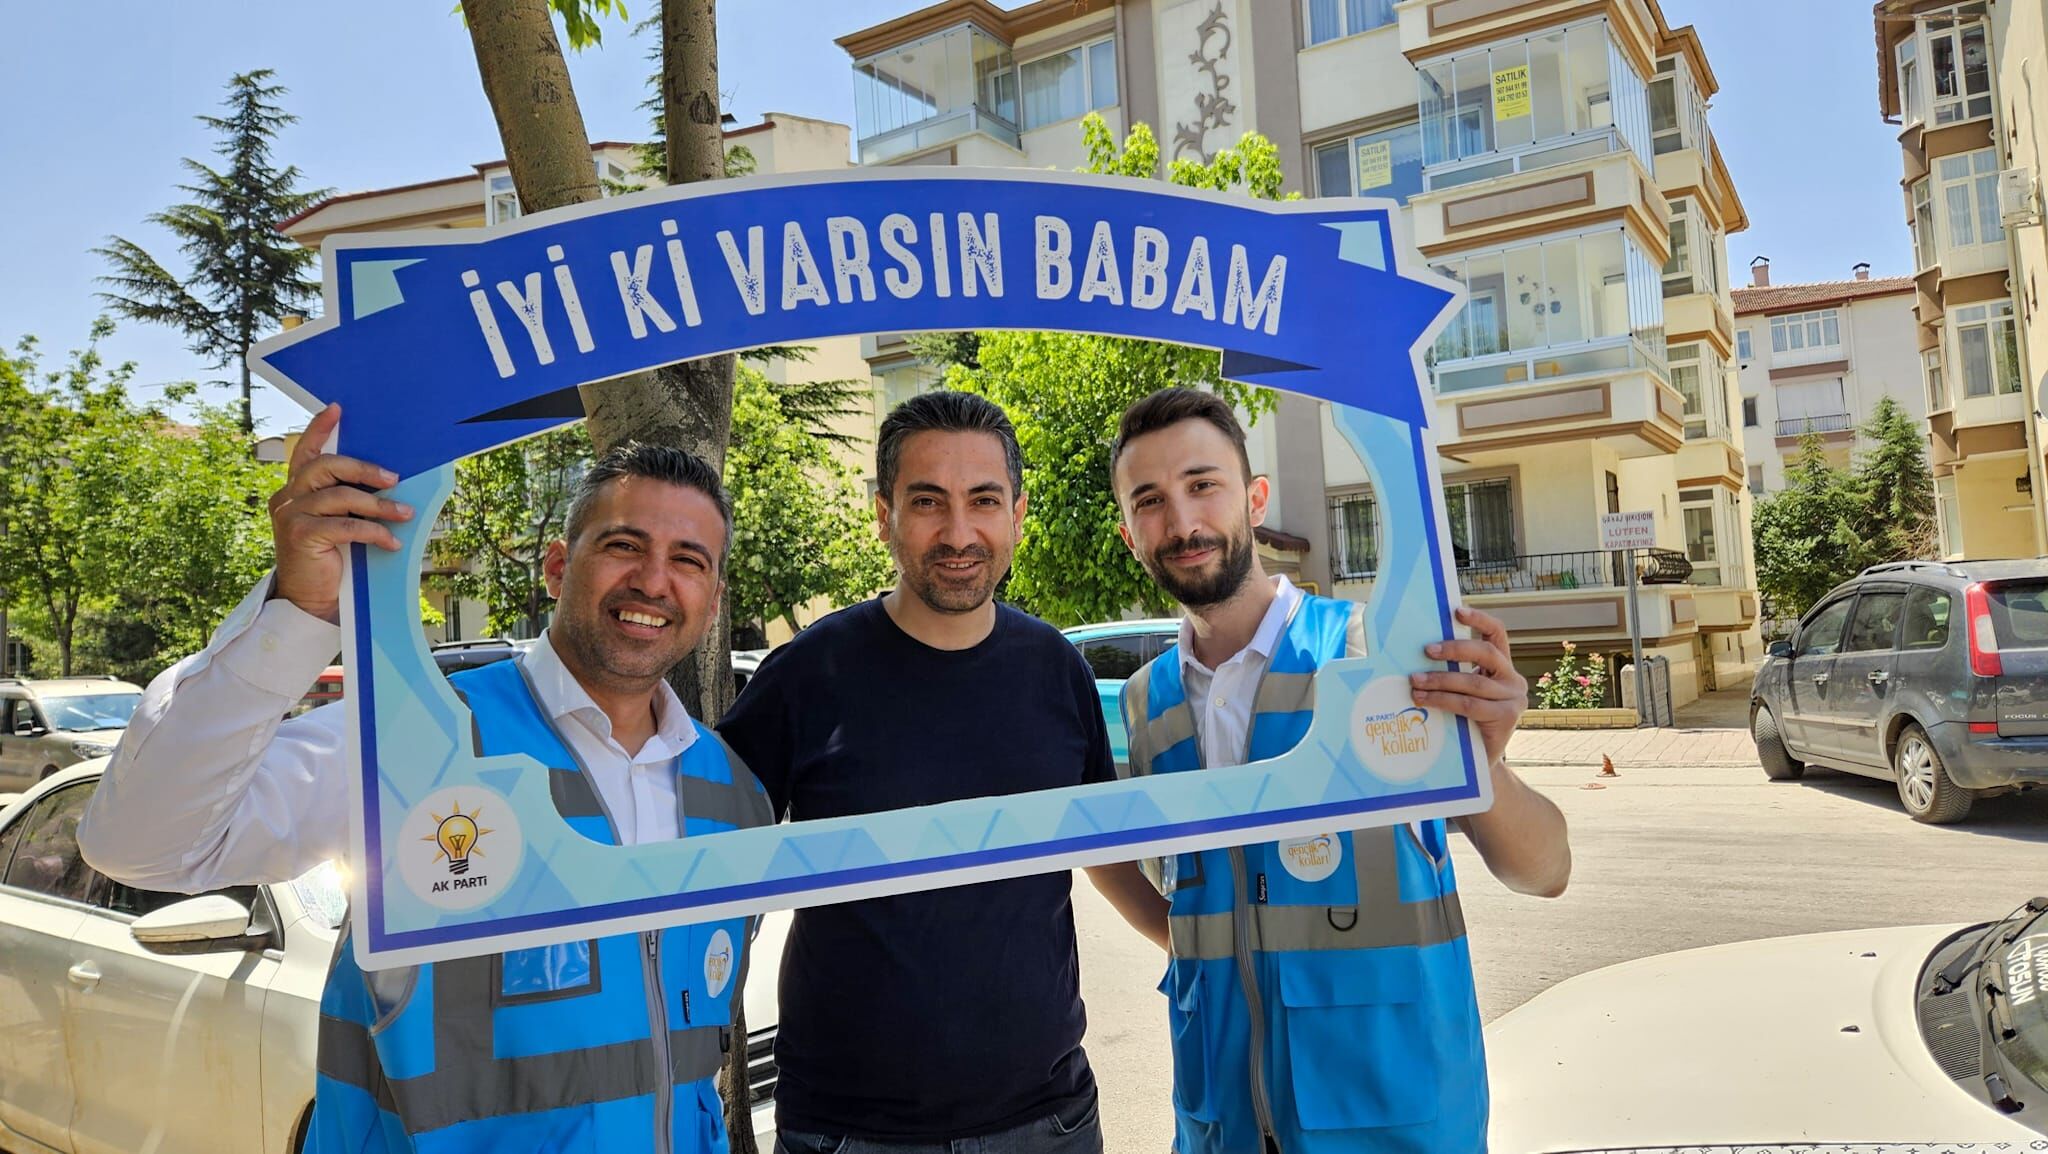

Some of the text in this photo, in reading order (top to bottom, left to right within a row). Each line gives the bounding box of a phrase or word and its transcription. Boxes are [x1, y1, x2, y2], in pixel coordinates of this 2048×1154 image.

[1496, 69, 1527, 84] SATILIK
[461, 212, 1287, 378] İYİ Kİ VARSIN BABAM
[1366, 716, 1410, 744] gençlik
[431, 881, 449, 893] AK
